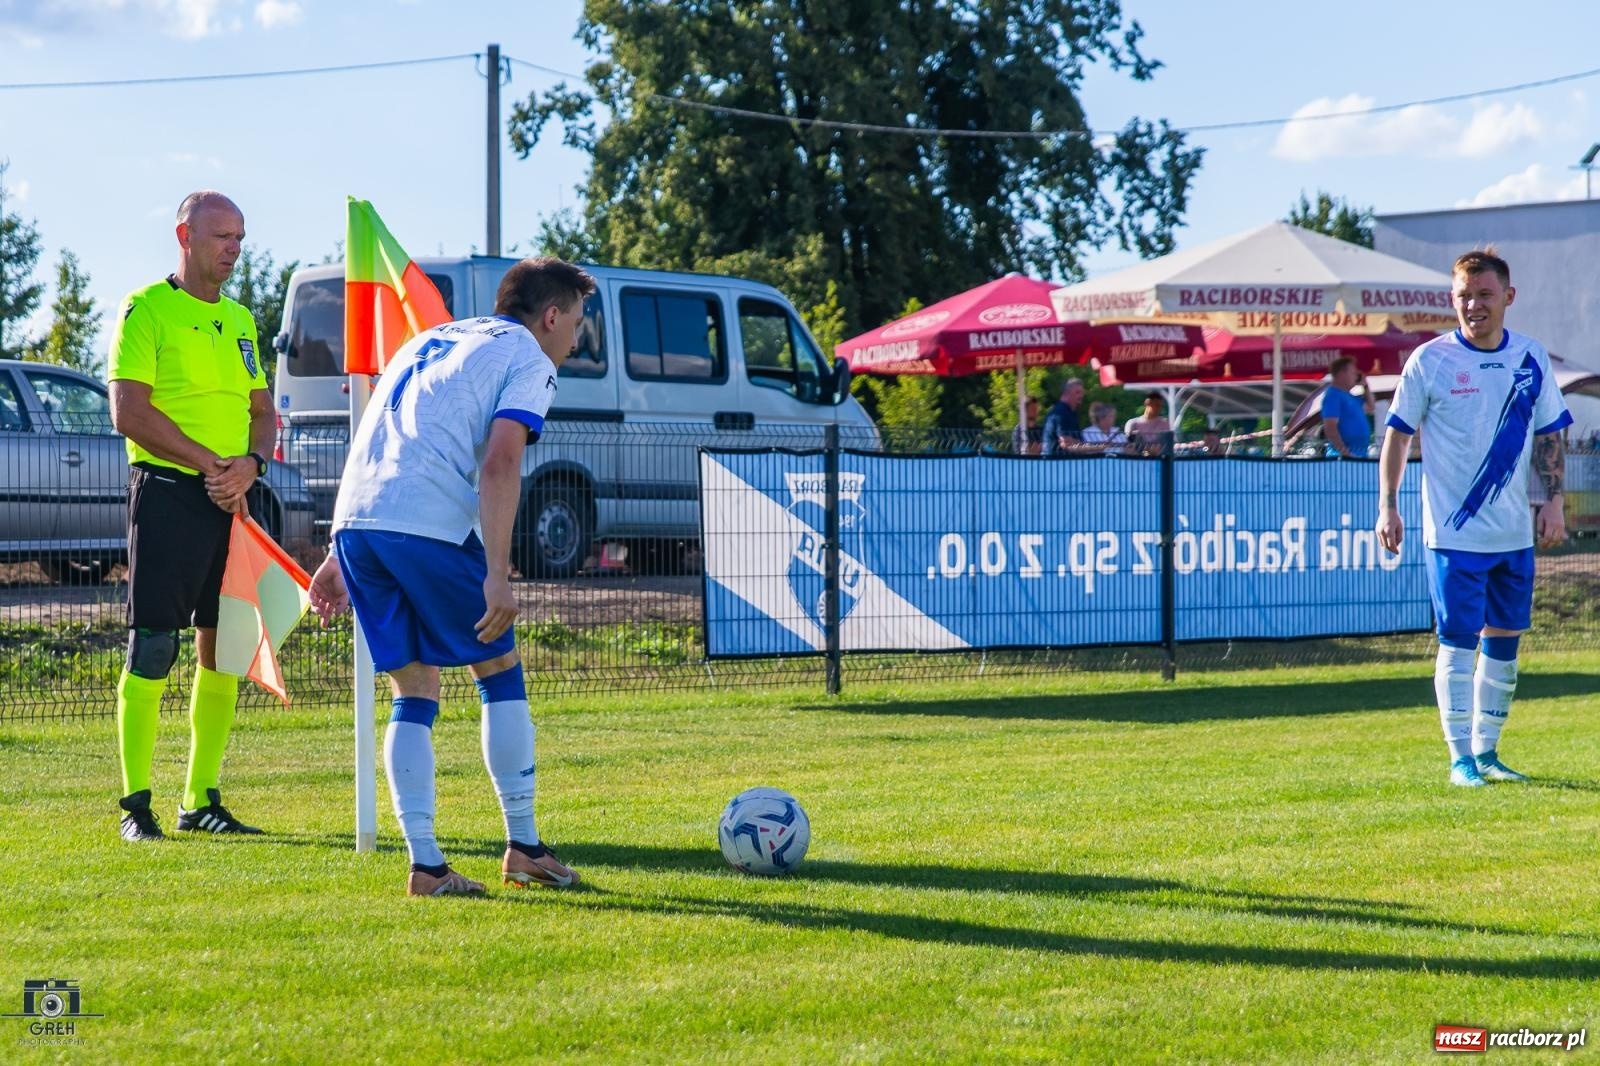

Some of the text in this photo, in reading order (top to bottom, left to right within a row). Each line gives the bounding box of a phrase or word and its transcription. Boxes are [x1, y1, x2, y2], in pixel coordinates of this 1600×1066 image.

[1062, 291, 1147, 313] RACIBORSKIE
[1179, 287, 1324, 307] RACIBORSKIE
[1361, 288, 1453, 308] RACIBORS
[969, 327, 1066, 350] RACIBORSKIE
